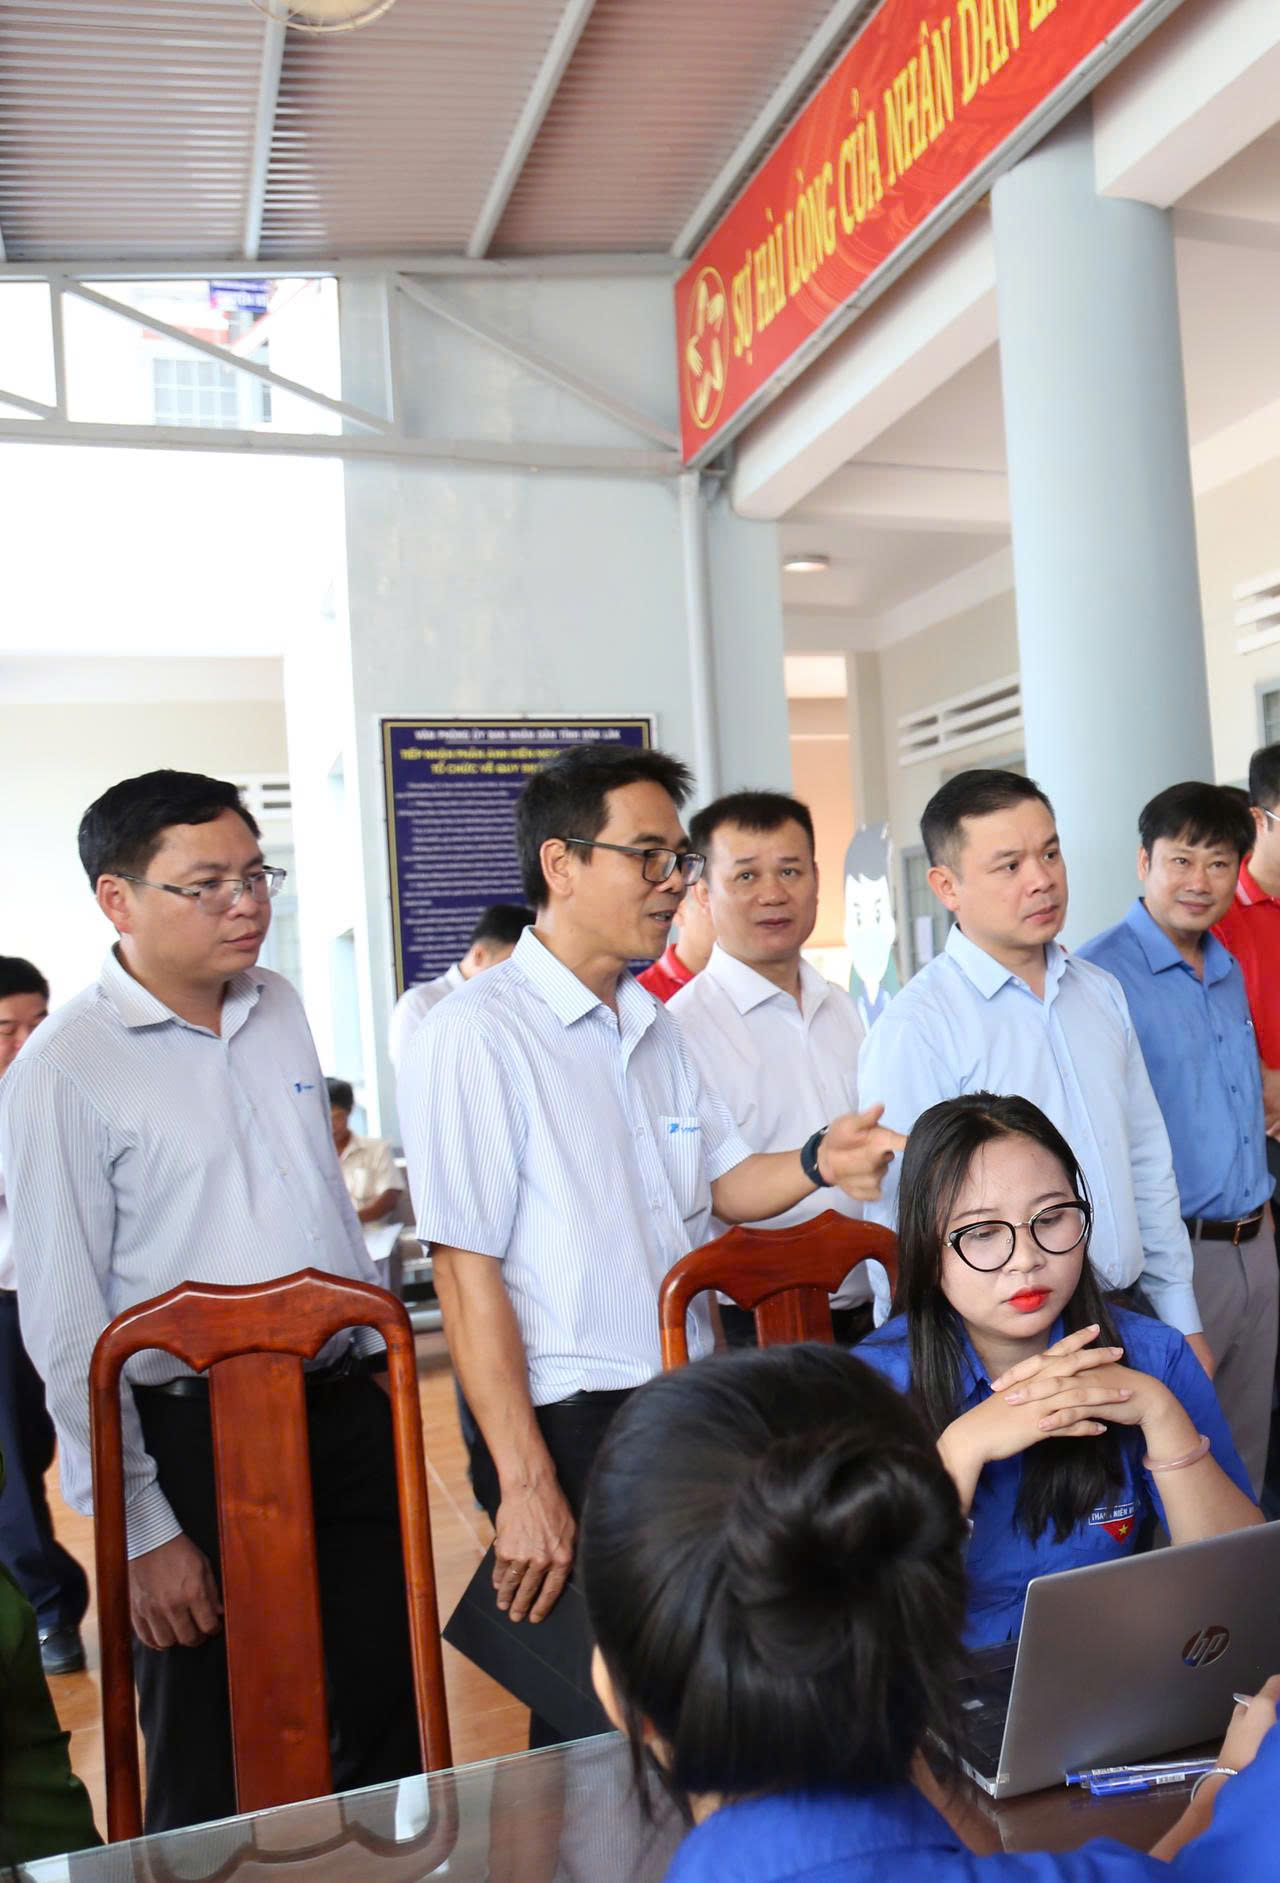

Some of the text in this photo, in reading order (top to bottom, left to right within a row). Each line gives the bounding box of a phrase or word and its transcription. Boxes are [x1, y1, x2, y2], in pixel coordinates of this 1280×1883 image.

[754, 208, 787, 332] HÀI
[786, 161, 837, 297] LÒNG
[838, 87, 884, 236] CỦA
[884, 17, 955, 186] NHÂN
